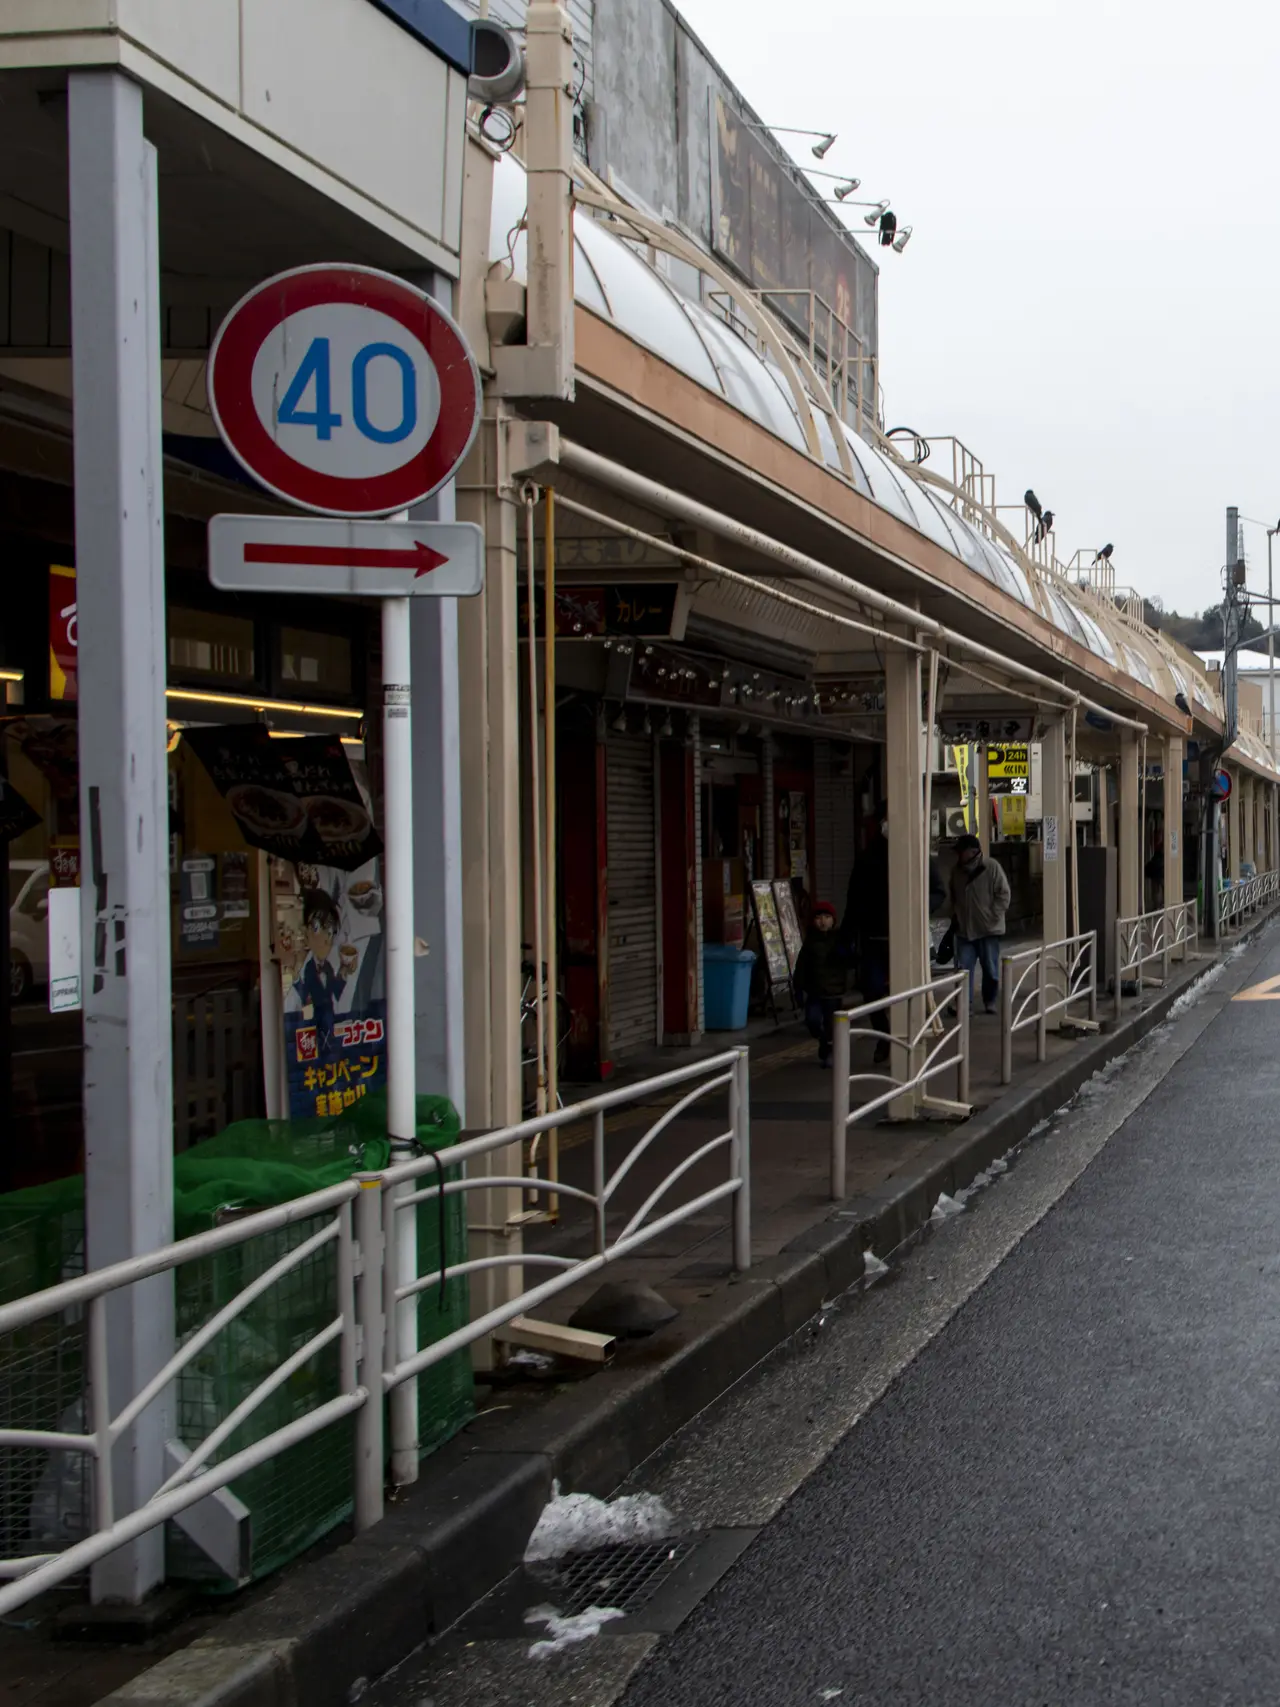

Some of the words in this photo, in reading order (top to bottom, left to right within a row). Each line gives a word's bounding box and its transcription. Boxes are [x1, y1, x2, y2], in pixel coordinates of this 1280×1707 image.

[277, 337, 417, 444] 40
[615, 598, 663, 624] カレー
[1007, 750, 1027, 761] 24h
[1014, 764, 1027, 775] IN
[1010, 777, 1027, 794] 空
[341, 1019, 384, 1047] コナン
[304, 1055, 379, 1091] キャンペーン
